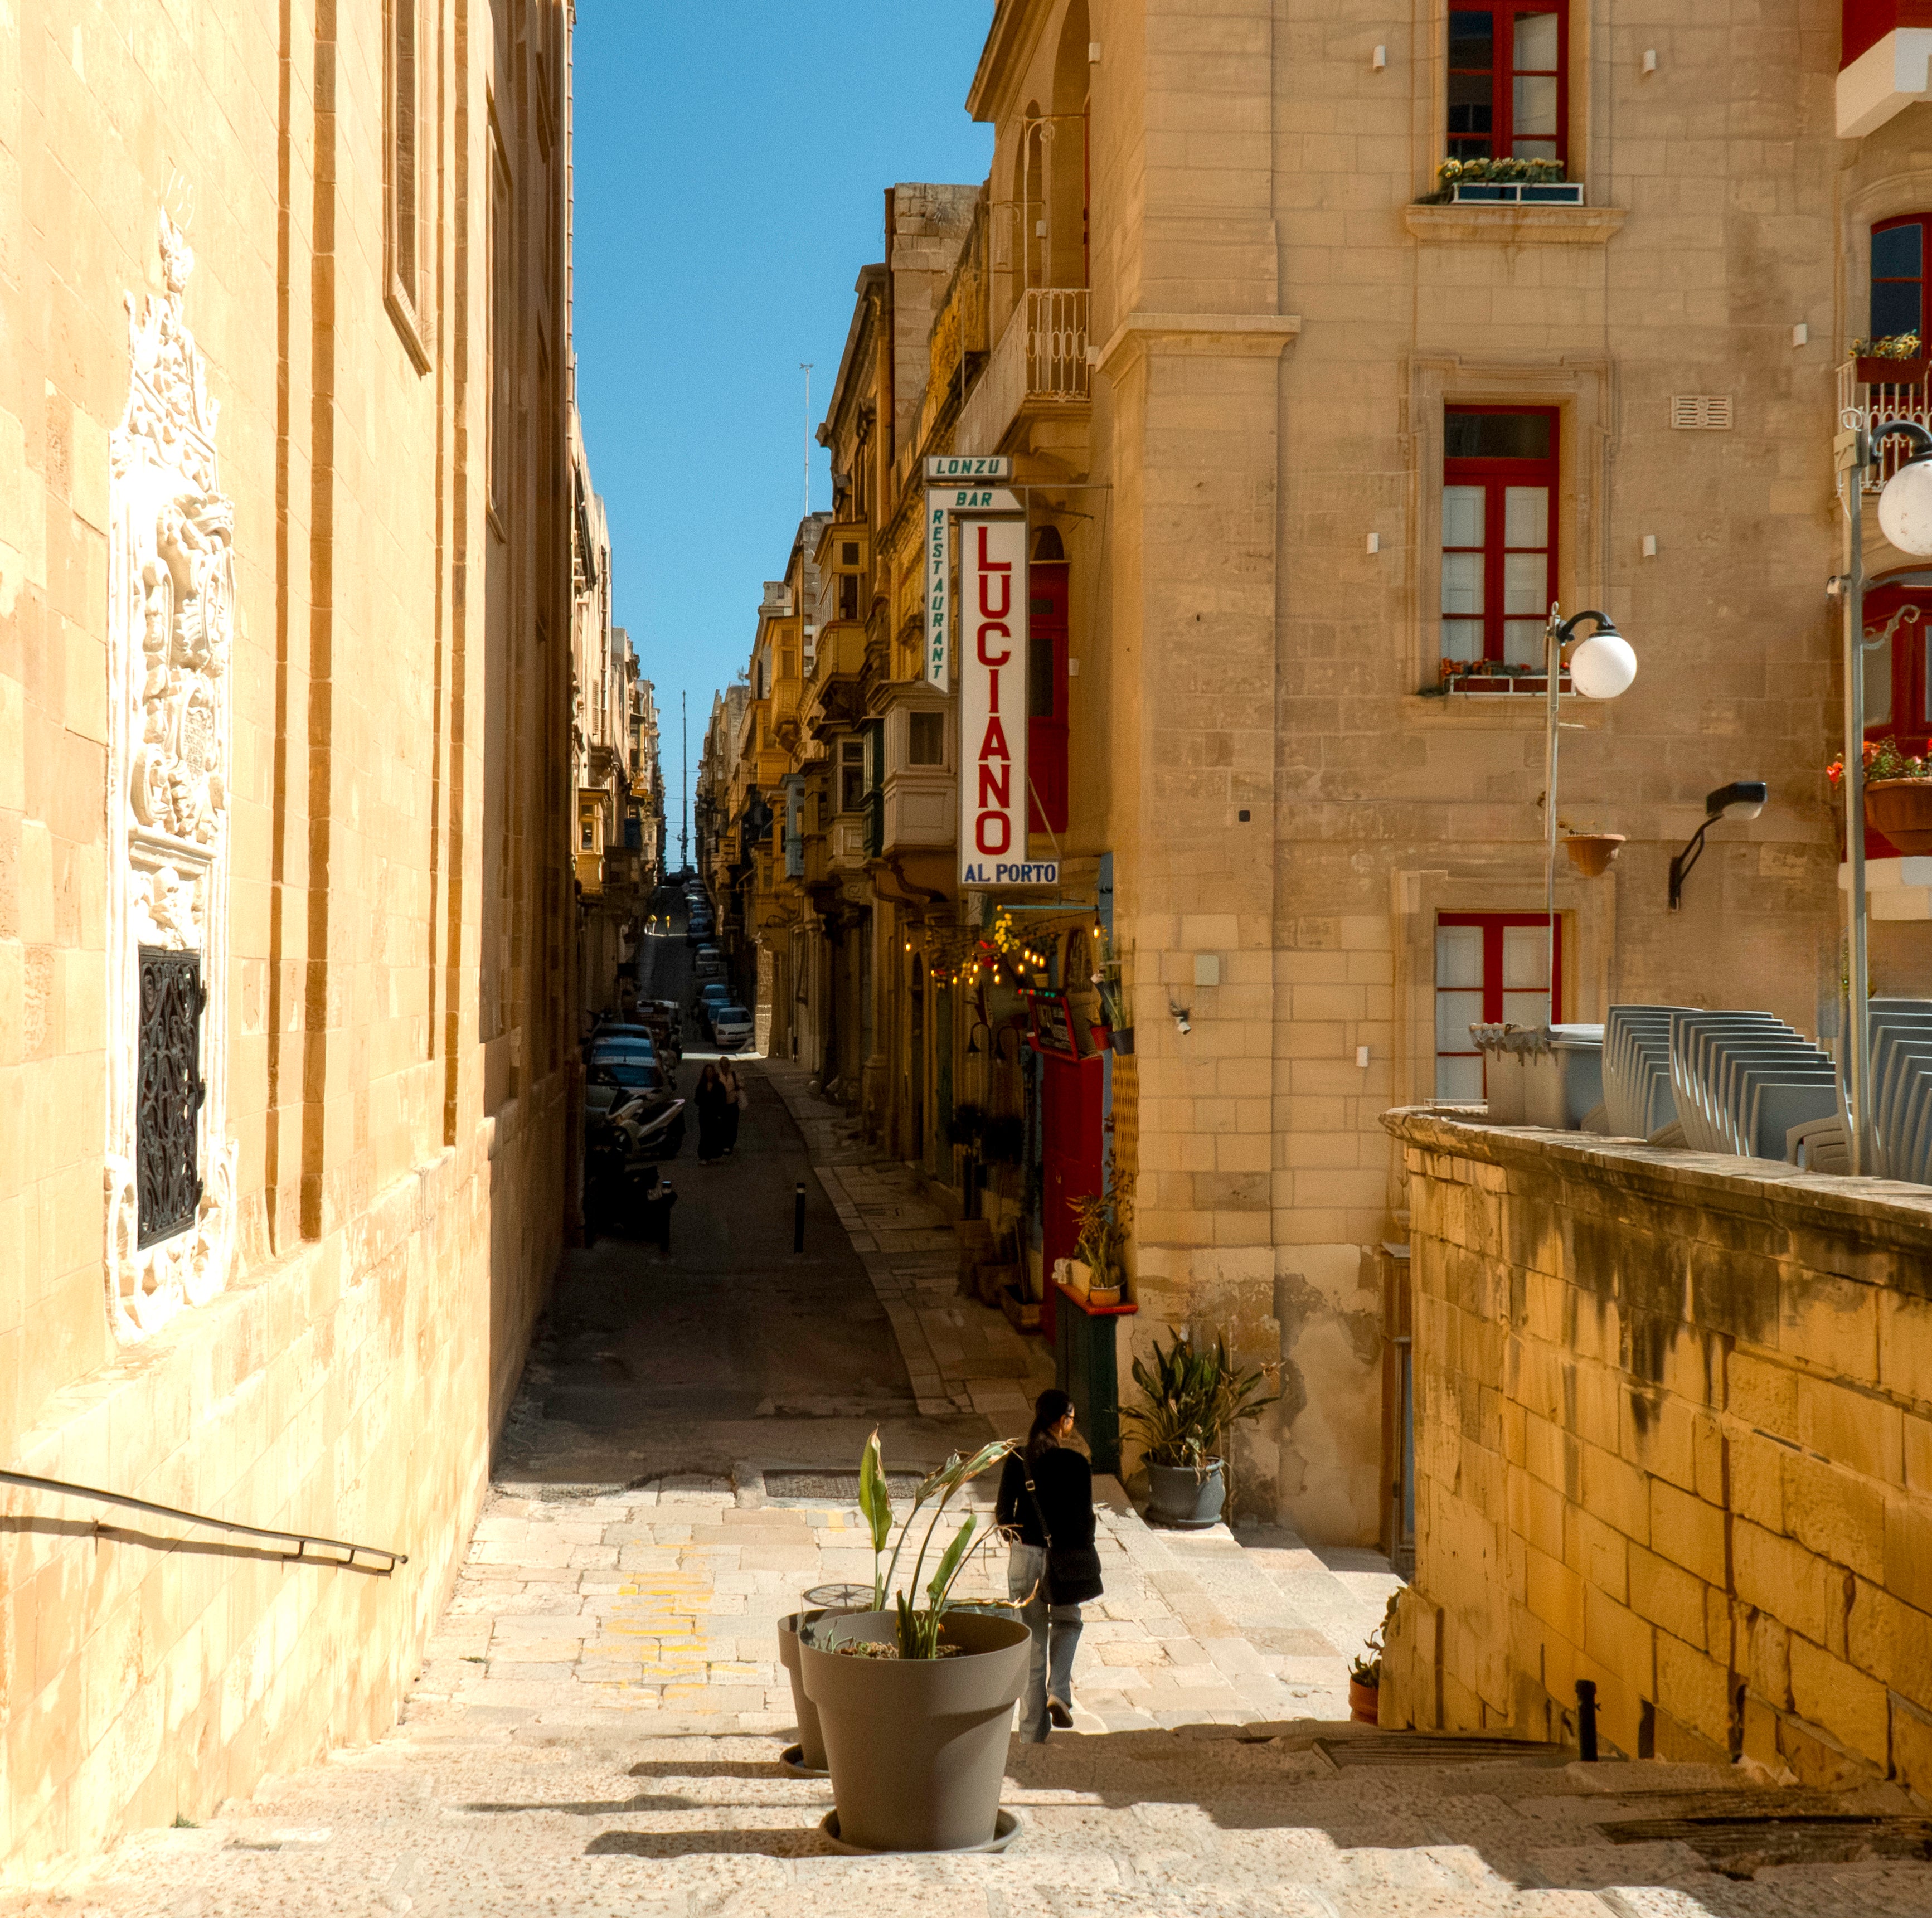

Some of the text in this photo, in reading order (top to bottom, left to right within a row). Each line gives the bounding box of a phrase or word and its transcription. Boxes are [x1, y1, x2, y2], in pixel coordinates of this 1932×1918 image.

[936, 459, 1001, 475] LONZU
[955, 492, 992, 507] BAR
[932, 509, 944, 679] RESTAURANT
[975, 526, 1012, 856] LUCIANO
[964, 863, 1056, 883] AL PORTO
